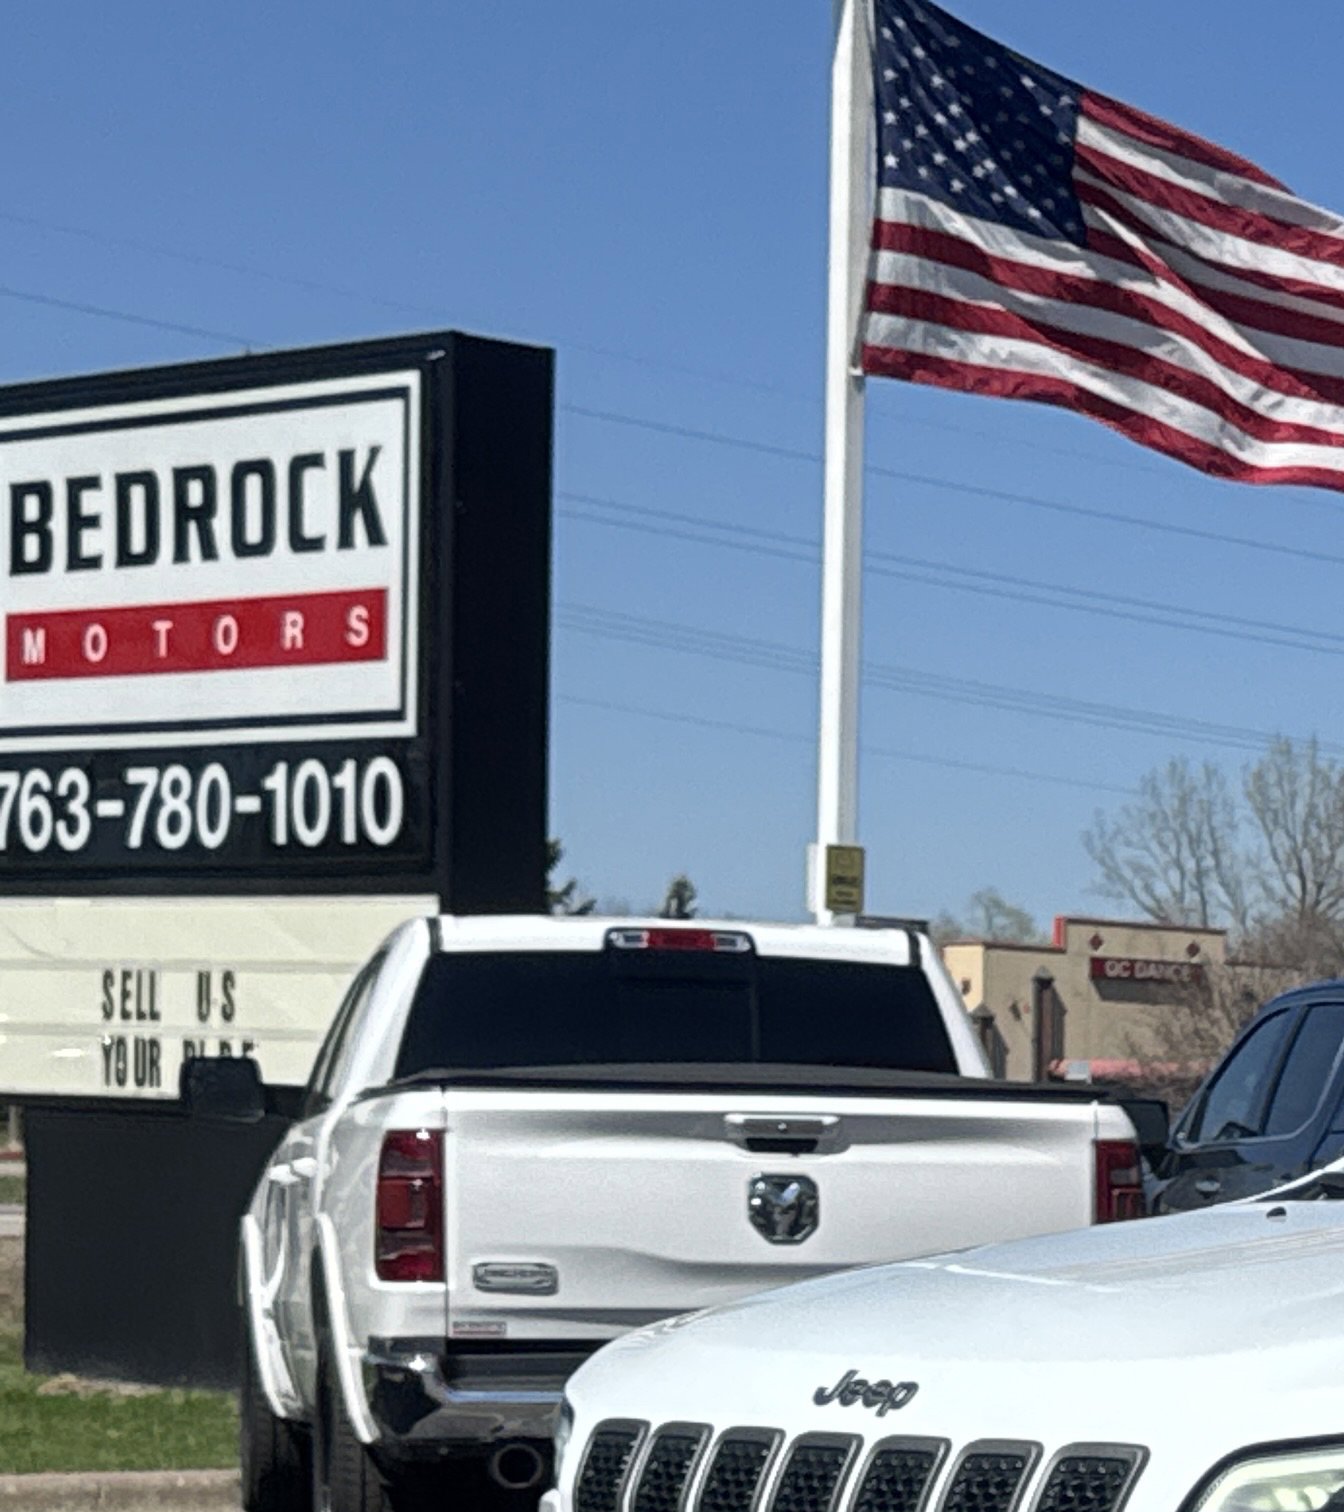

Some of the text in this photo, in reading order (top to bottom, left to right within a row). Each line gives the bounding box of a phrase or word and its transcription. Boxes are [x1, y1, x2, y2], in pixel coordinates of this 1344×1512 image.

[10, 445, 388, 576] BEDROCK
[22, 605, 371, 665] MOTORS
[0, 756, 402, 852] 763-780-1010
[102, 969, 236, 1023] SELL US
[102, 1035, 161, 1088] YOUR
[812, 1369, 919, 1418] Jeep
